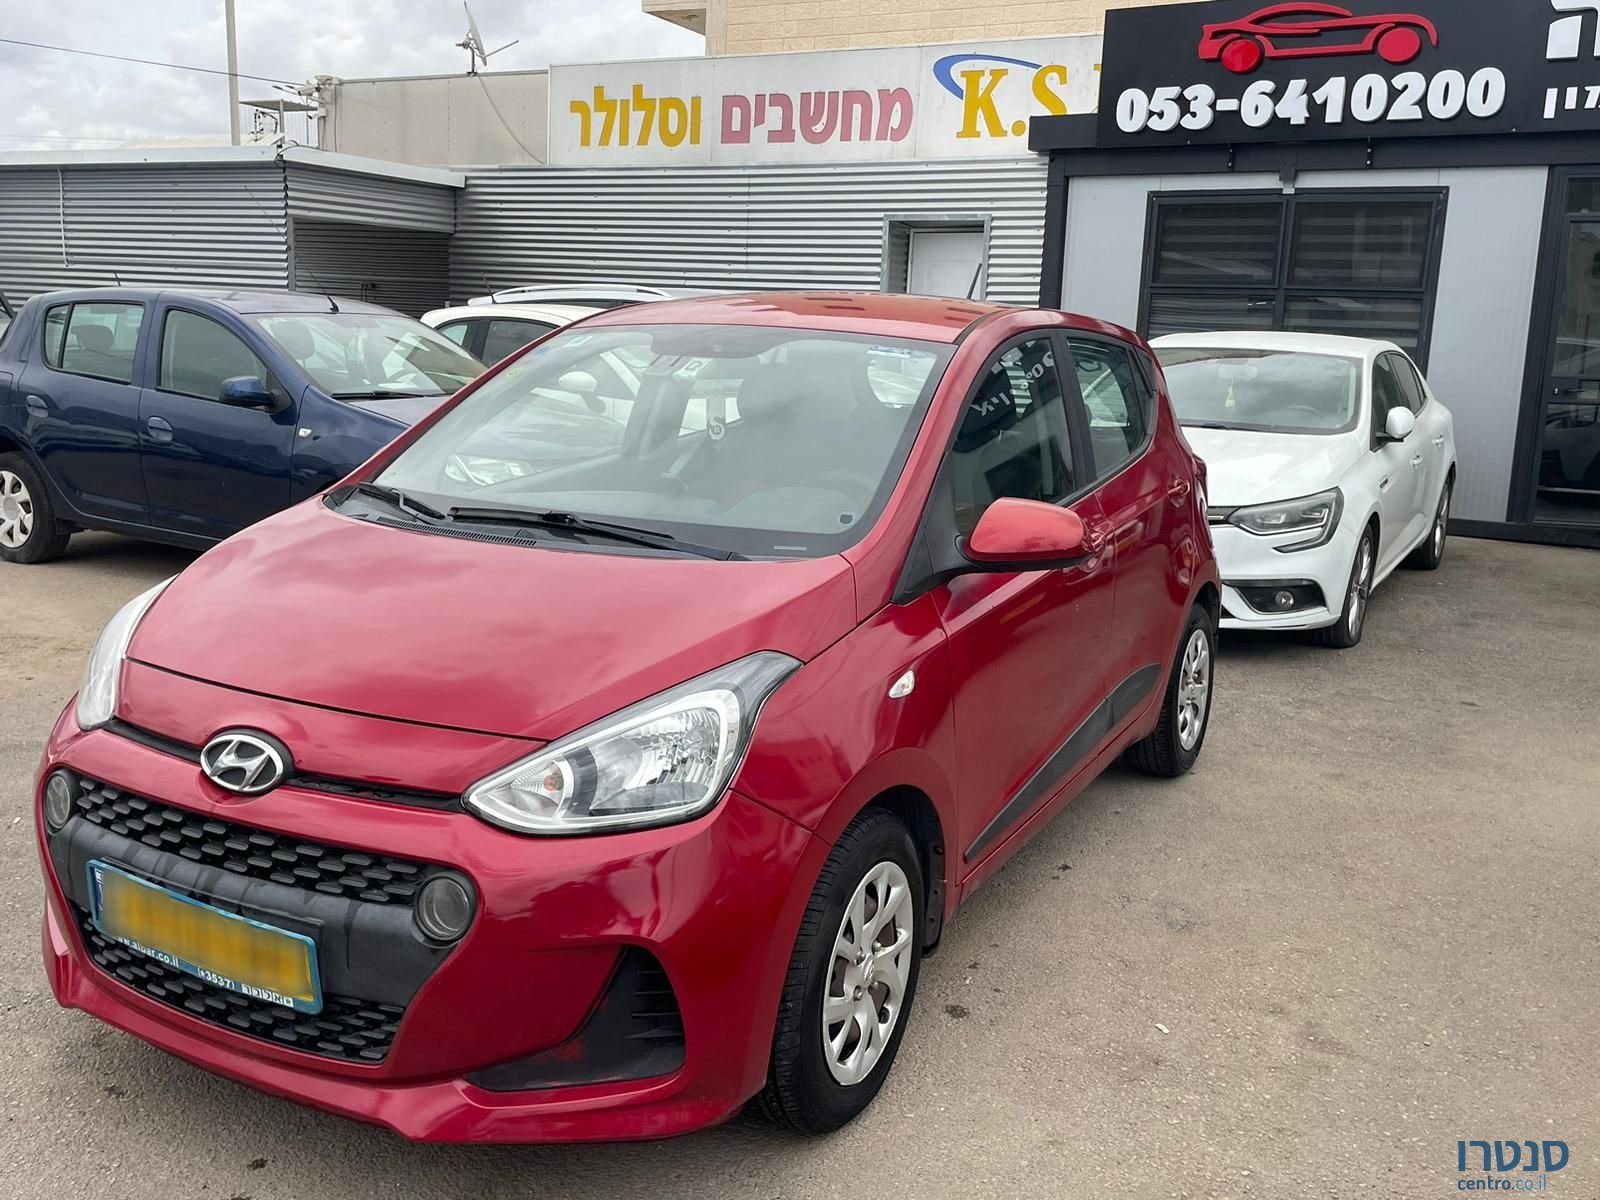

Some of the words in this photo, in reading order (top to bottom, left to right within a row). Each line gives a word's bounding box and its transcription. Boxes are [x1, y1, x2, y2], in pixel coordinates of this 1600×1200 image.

[569, 84, 702, 148] וסלולר
[720, 87, 914, 145] מחשבים
[1116, 66, 1506, 133] 053-6410200
